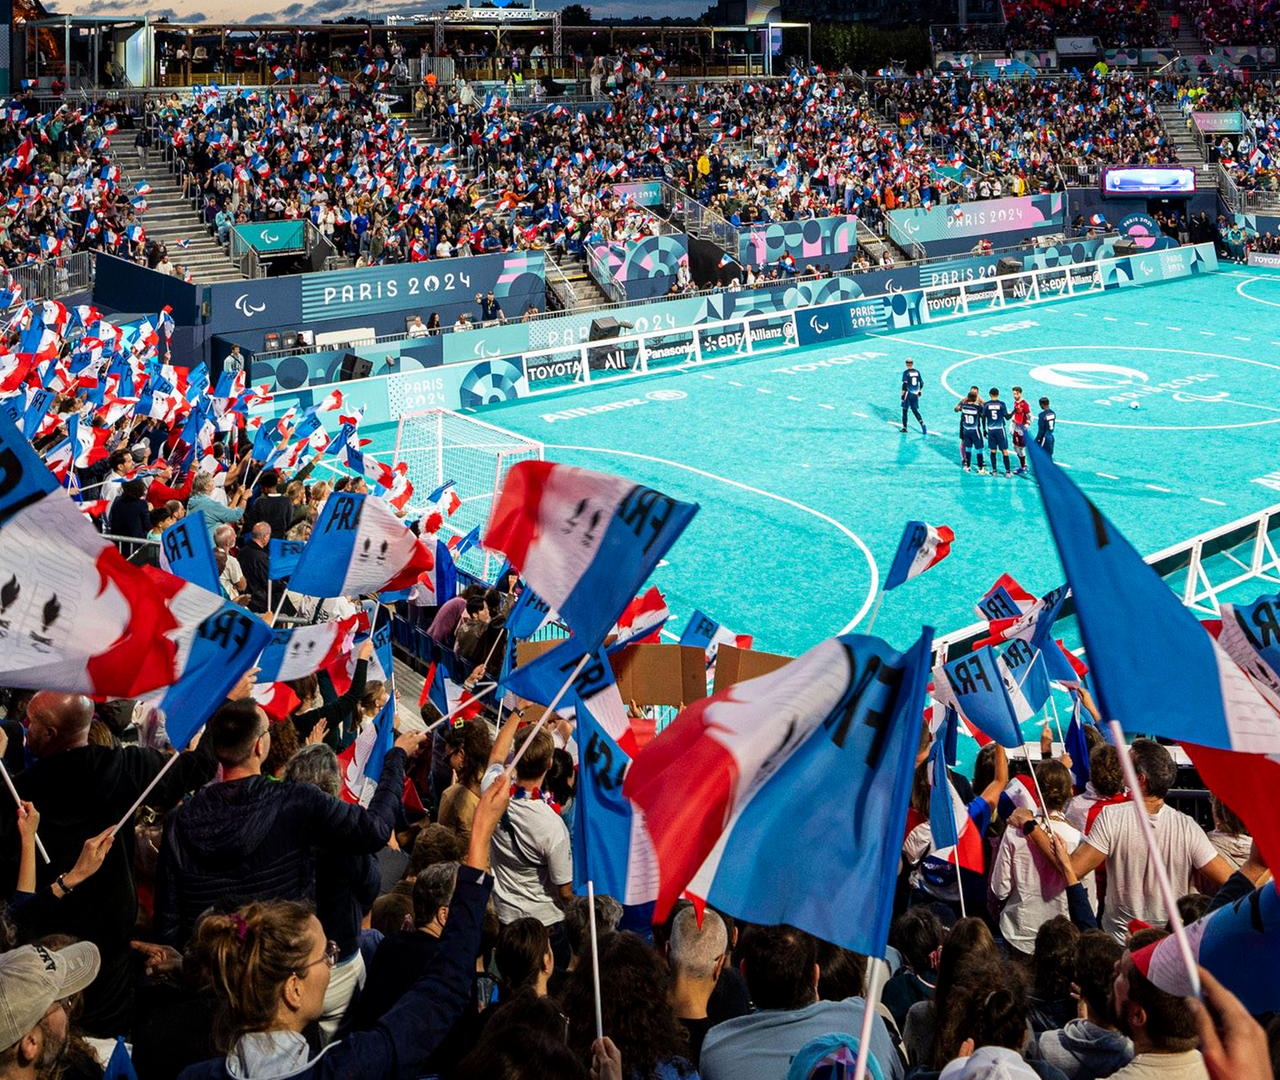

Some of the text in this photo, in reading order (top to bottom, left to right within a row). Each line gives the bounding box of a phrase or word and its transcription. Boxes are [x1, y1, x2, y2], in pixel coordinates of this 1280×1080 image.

[991, 208, 1023, 223] 2024
[408, 272, 471, 296] 2024
[928, 296, 962, 311] TOYOTA
[851, 317, 878, 329] 2024
[749, 327, 782, 343] Allianz
[604, 350, 626, 370] All
[644, 342, 696, 361] Panasonic
[528, 360, 581, 380] TOYOTA
[771, 351, 888, 375] TOYOTA
[405, 377, 444, 394] PARIS
[406, 392, 446, 409] 2024
[539, 398, 644, 423] Allianz
[990, 410, 998, 420] 5
